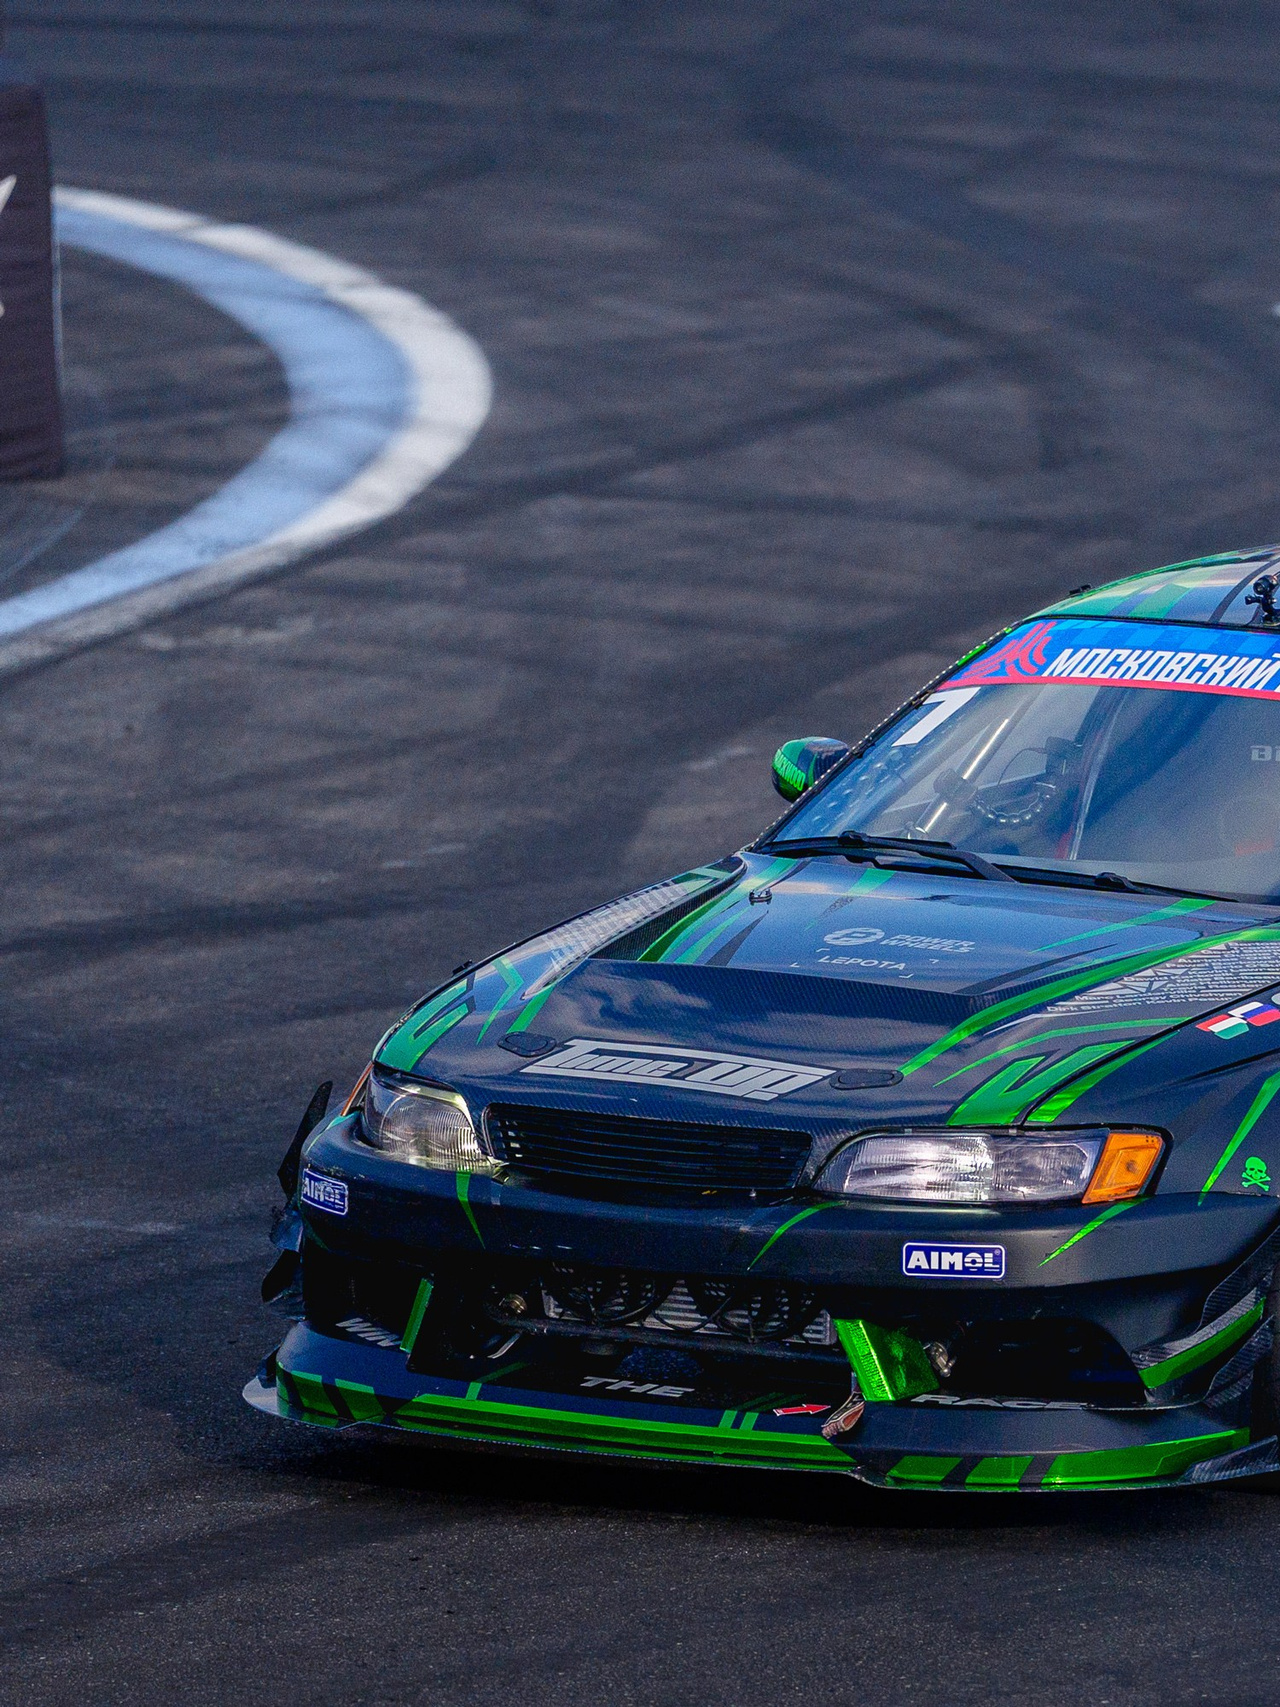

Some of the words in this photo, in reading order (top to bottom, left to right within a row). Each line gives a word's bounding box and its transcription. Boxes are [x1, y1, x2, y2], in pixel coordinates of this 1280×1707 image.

[818, 956, 906, 970] LEPOTA
[907, 1250, 1000, 1272] AIMOL
[580, 1376, 695, 1398] THE
[911, 1394, 1090, 1411] RACE
